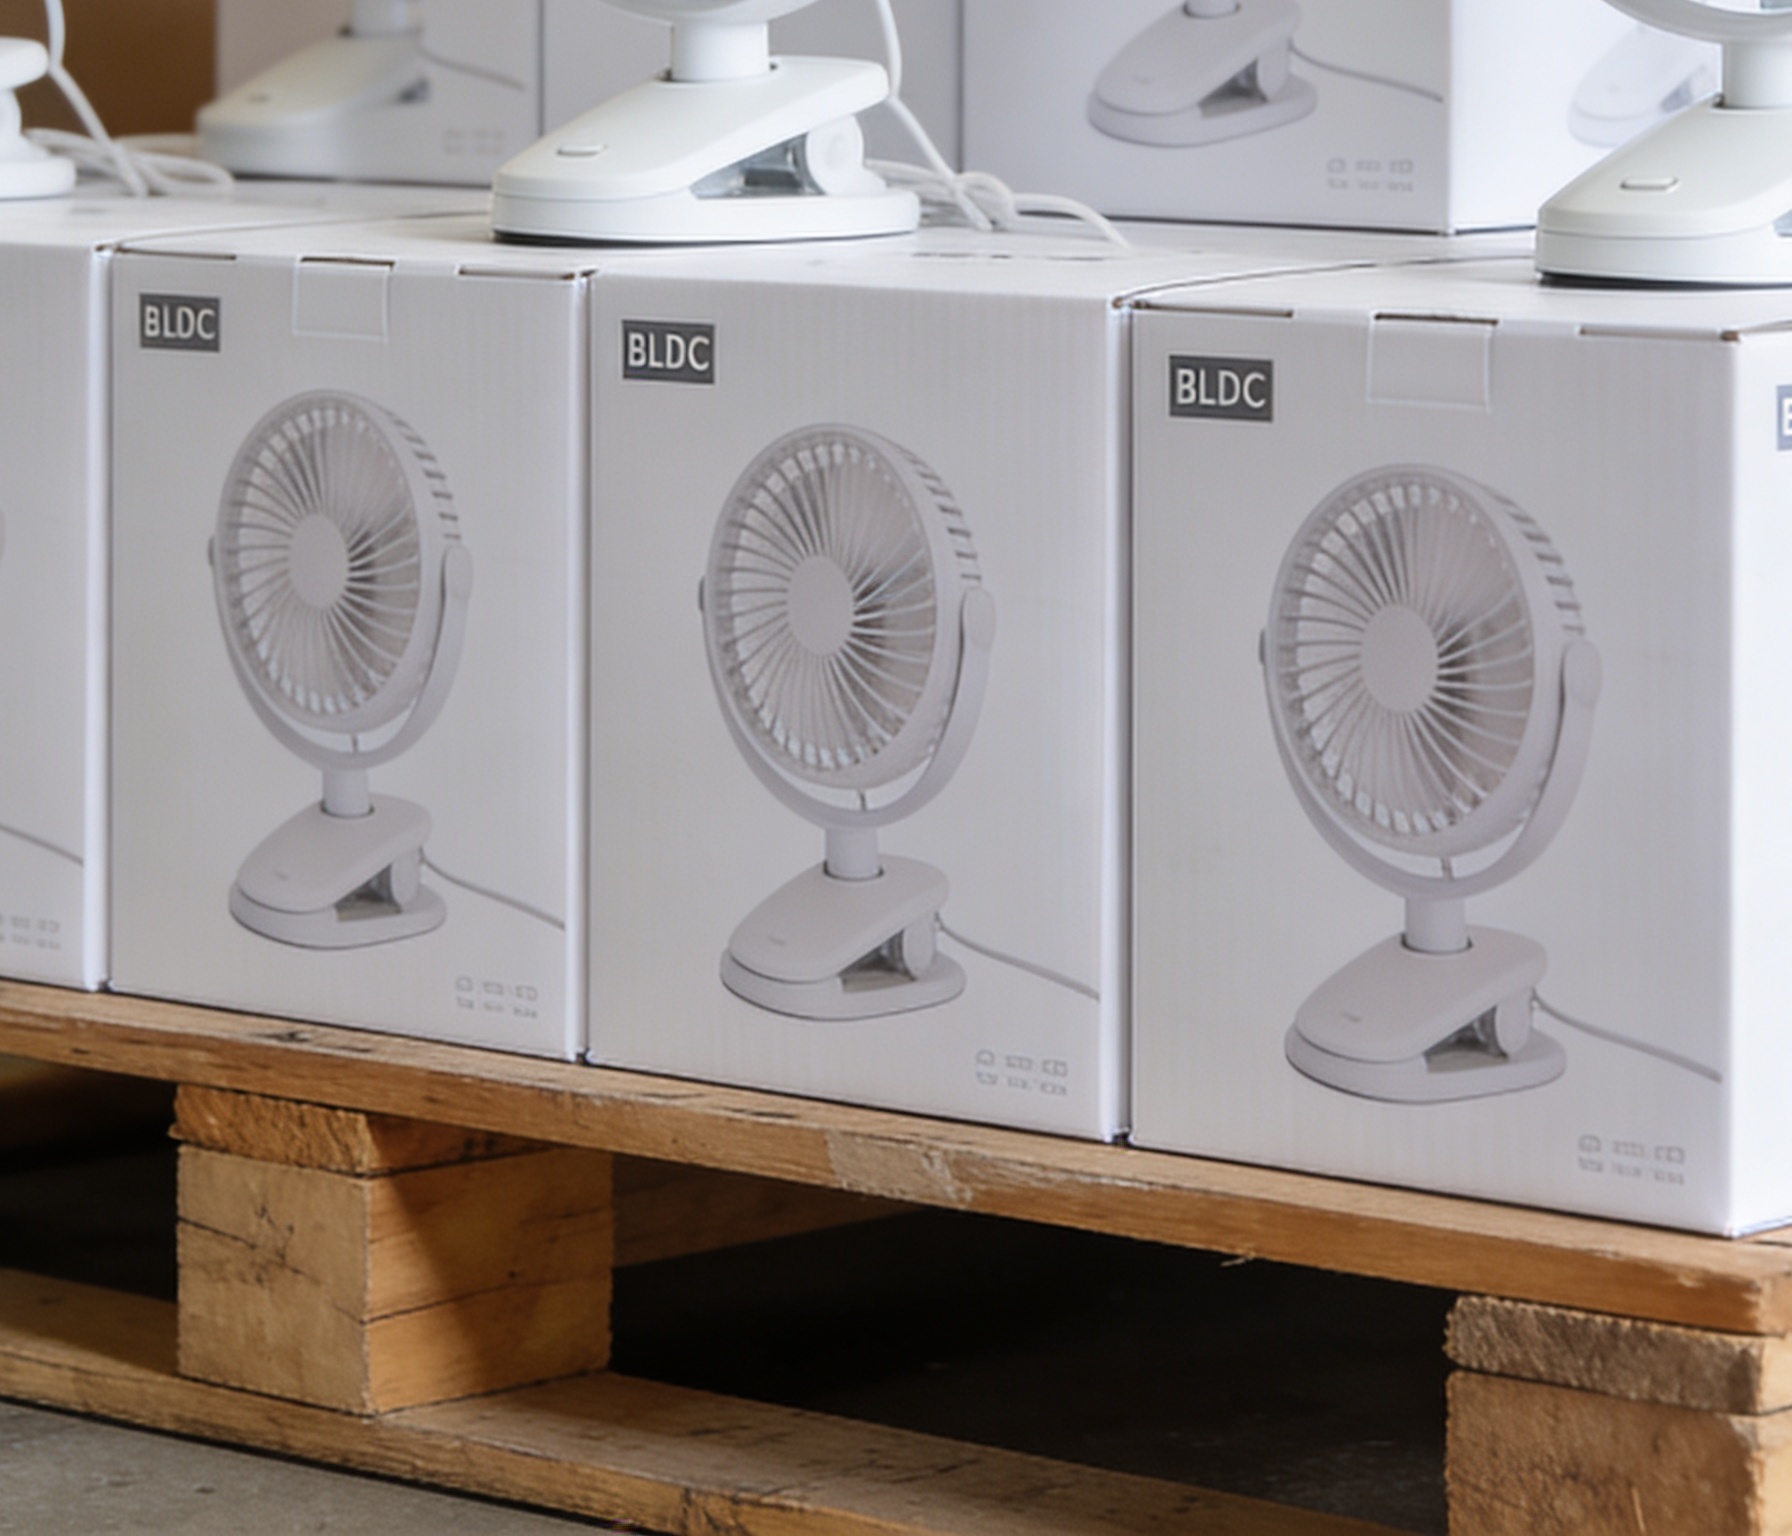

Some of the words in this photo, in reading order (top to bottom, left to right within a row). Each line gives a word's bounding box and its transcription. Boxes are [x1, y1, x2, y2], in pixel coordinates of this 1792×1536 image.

[144, 304, 216, 340] BLDC
[628, 333, 710, 371] BLDC
[1176, 368, 1266, 408] BLDC
